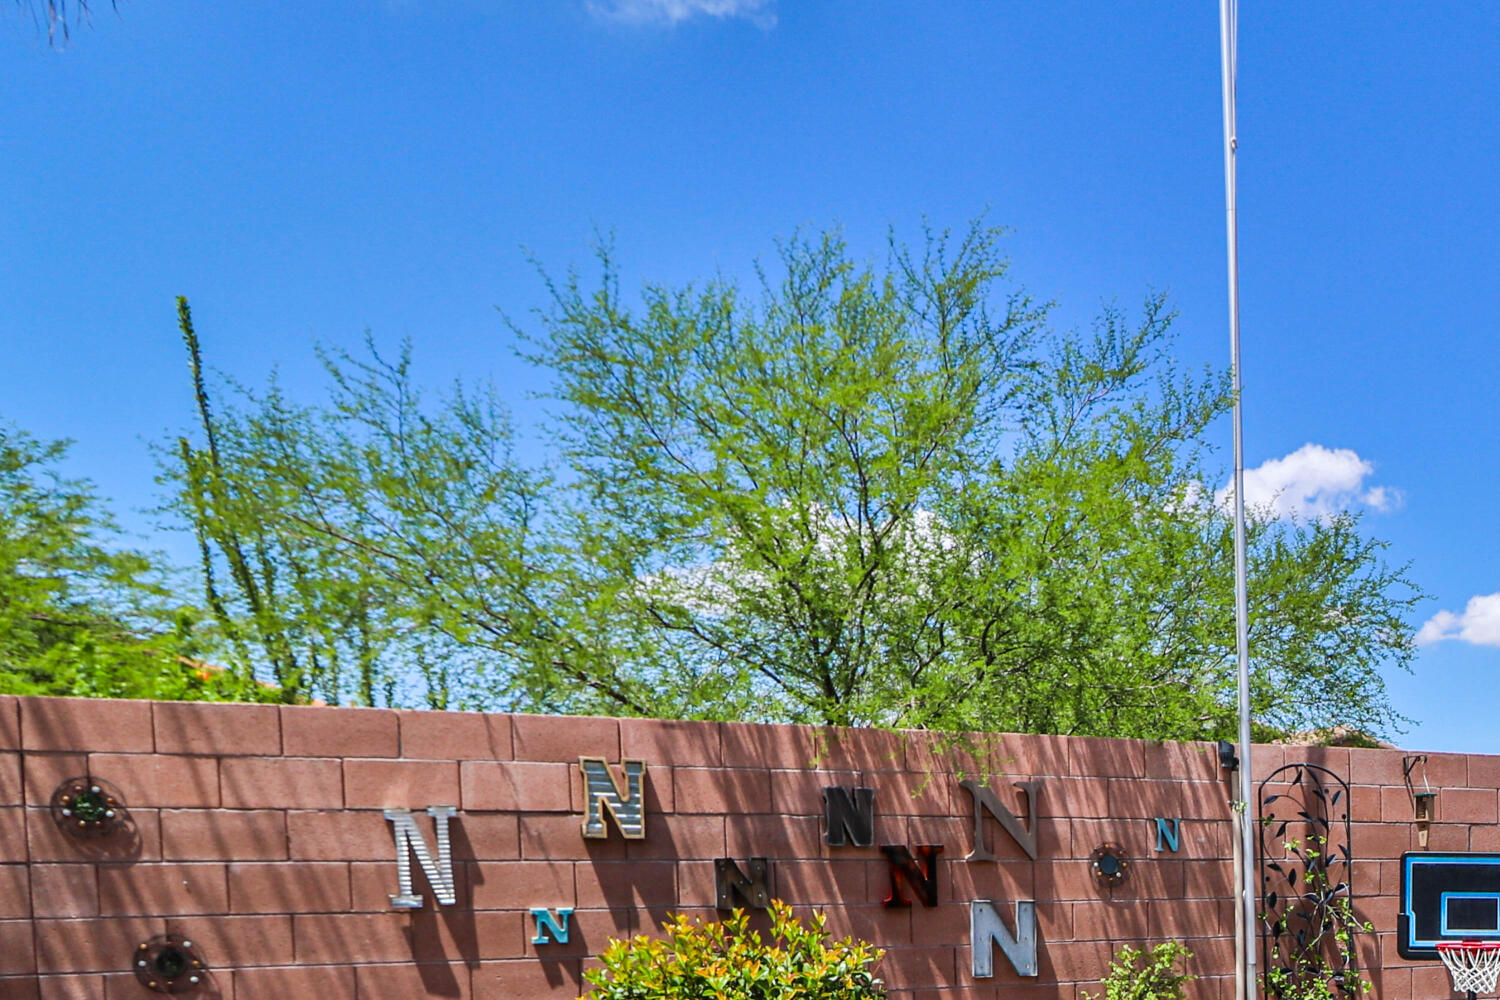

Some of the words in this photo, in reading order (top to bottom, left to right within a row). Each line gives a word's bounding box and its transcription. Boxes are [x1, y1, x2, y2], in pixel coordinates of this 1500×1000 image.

[579, 755, 646, 839] N
[822, 786, 875, 846] N
[958, 780, 1043, 862] N
[384, 805, 457, 908] N
[1154, 818, 1181, 852] N
[714, 857, 768, 909] N
[881, 845, 944, 907] N
[529, 907, 574, 944] N
[970, 900, 1038, 977] N
